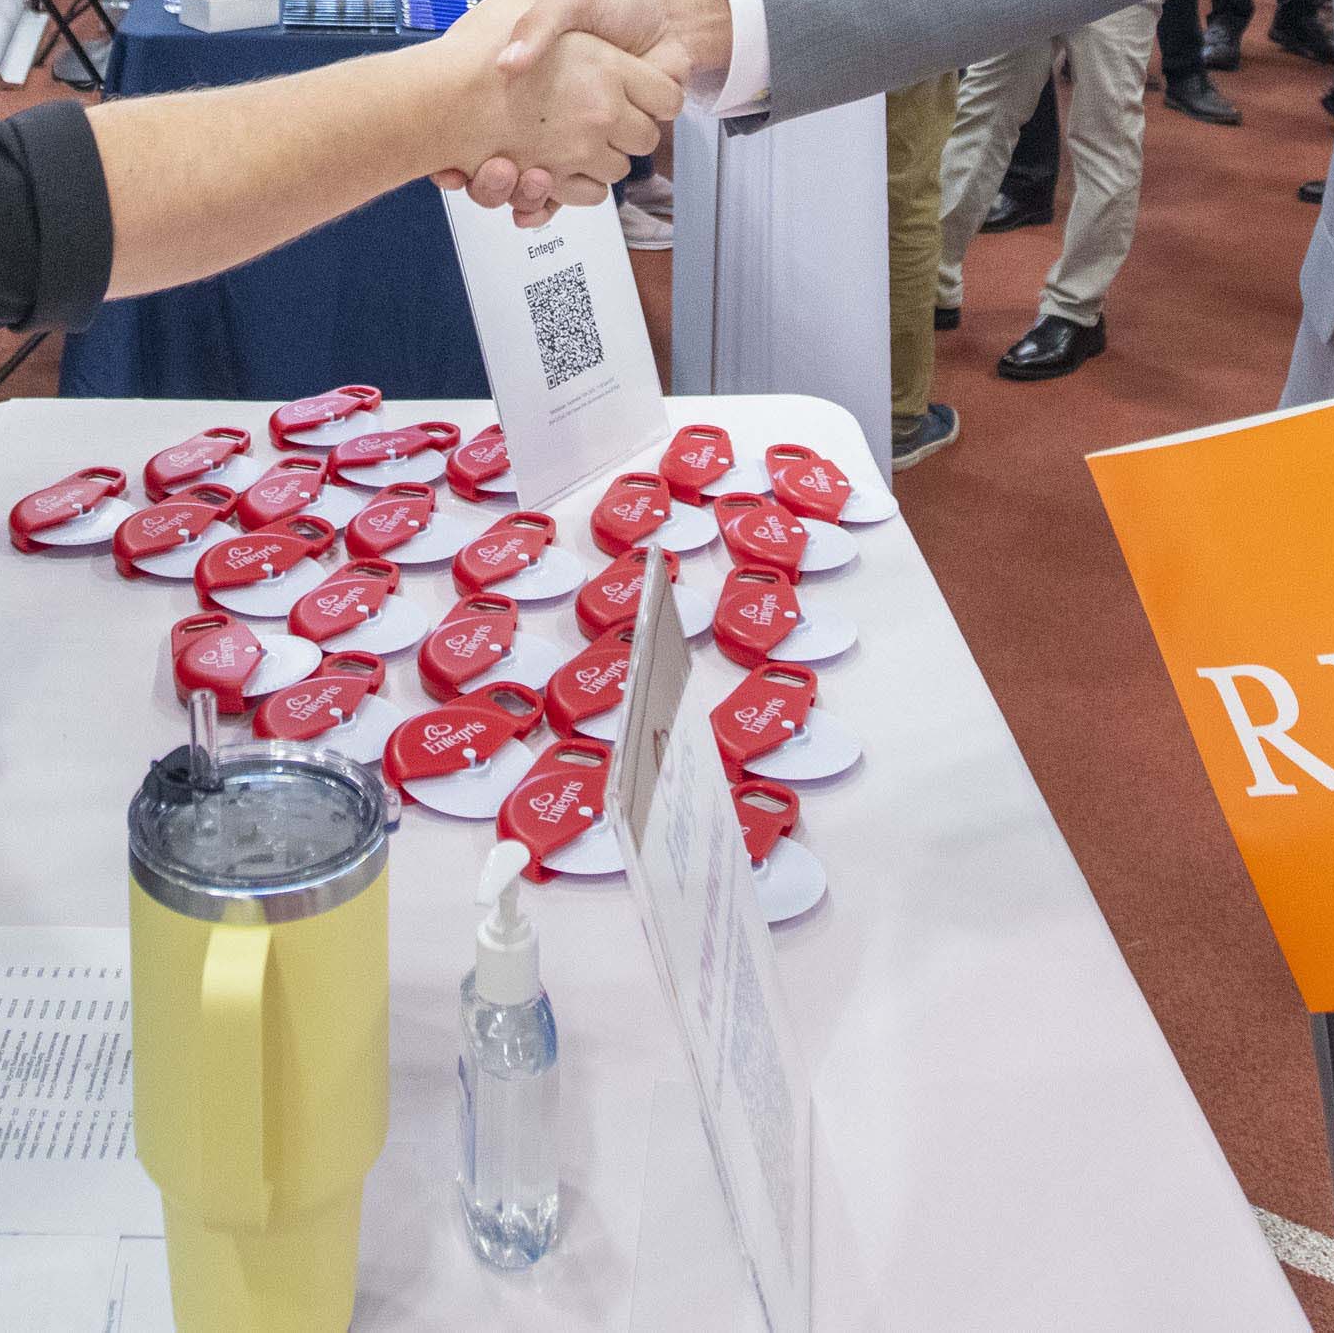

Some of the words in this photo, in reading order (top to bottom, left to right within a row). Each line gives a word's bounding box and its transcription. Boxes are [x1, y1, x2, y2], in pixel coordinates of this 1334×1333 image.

[527, 235, 565, 260] Entegris
[690, 445, 717, 470] Entegris
[142, 510, 193, 539] Entegris
[375, 504, 411, 534] Entegris
[622, 495, 652, 524] Entegris
[225, 542, 283, 570] Entegris
[482, 536, 524, 567] Entegris
[322, 585, 366, 618] Entegris
[753, 592, 781, 627] Entegris
[453, 624, 492, 659] Entegris
[579, 658, 630, 695] Entegris
[289, 684, 343, 722] Entegris
[742, 696, 787, 735] Entegris
[421, 720, 487, 756] Entegris
[538, 779, 584, 825] Entegris
